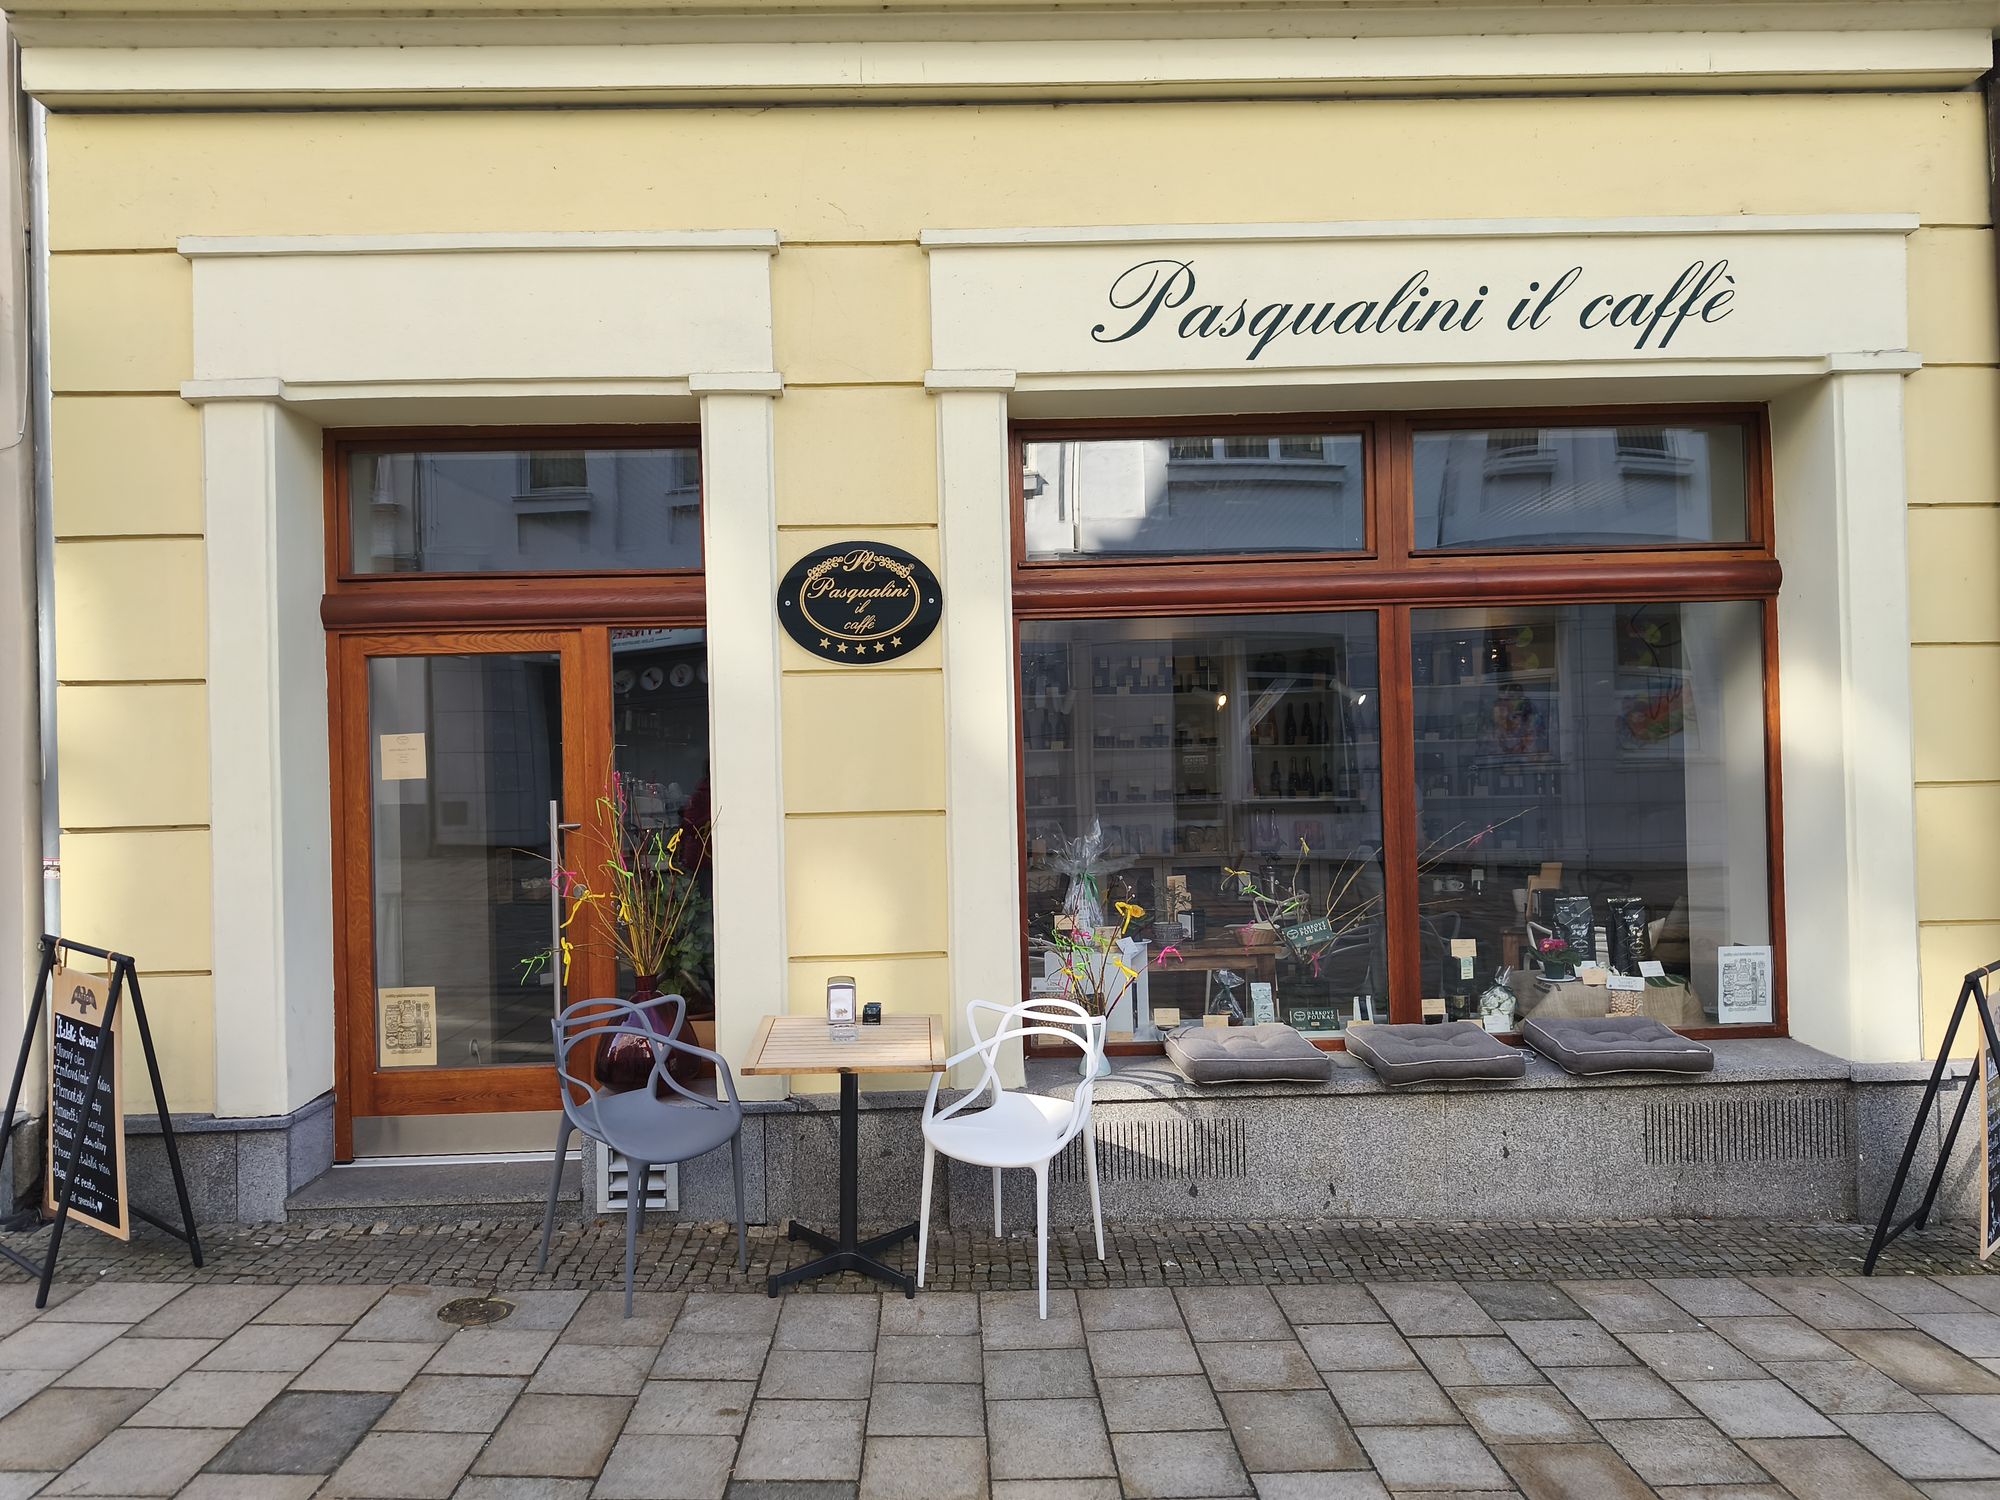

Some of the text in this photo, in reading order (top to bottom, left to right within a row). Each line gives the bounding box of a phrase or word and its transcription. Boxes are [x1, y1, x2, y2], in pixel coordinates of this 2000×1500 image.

[1091, 259, 1735, 360] Pasqualini il caffè
[807, 577, 911, 604] Pasqualini
[854, 599, 872, 614] il
[843, 615, 876, 634] caffè
[1300, 924, 1327, 936] POUKAZ
